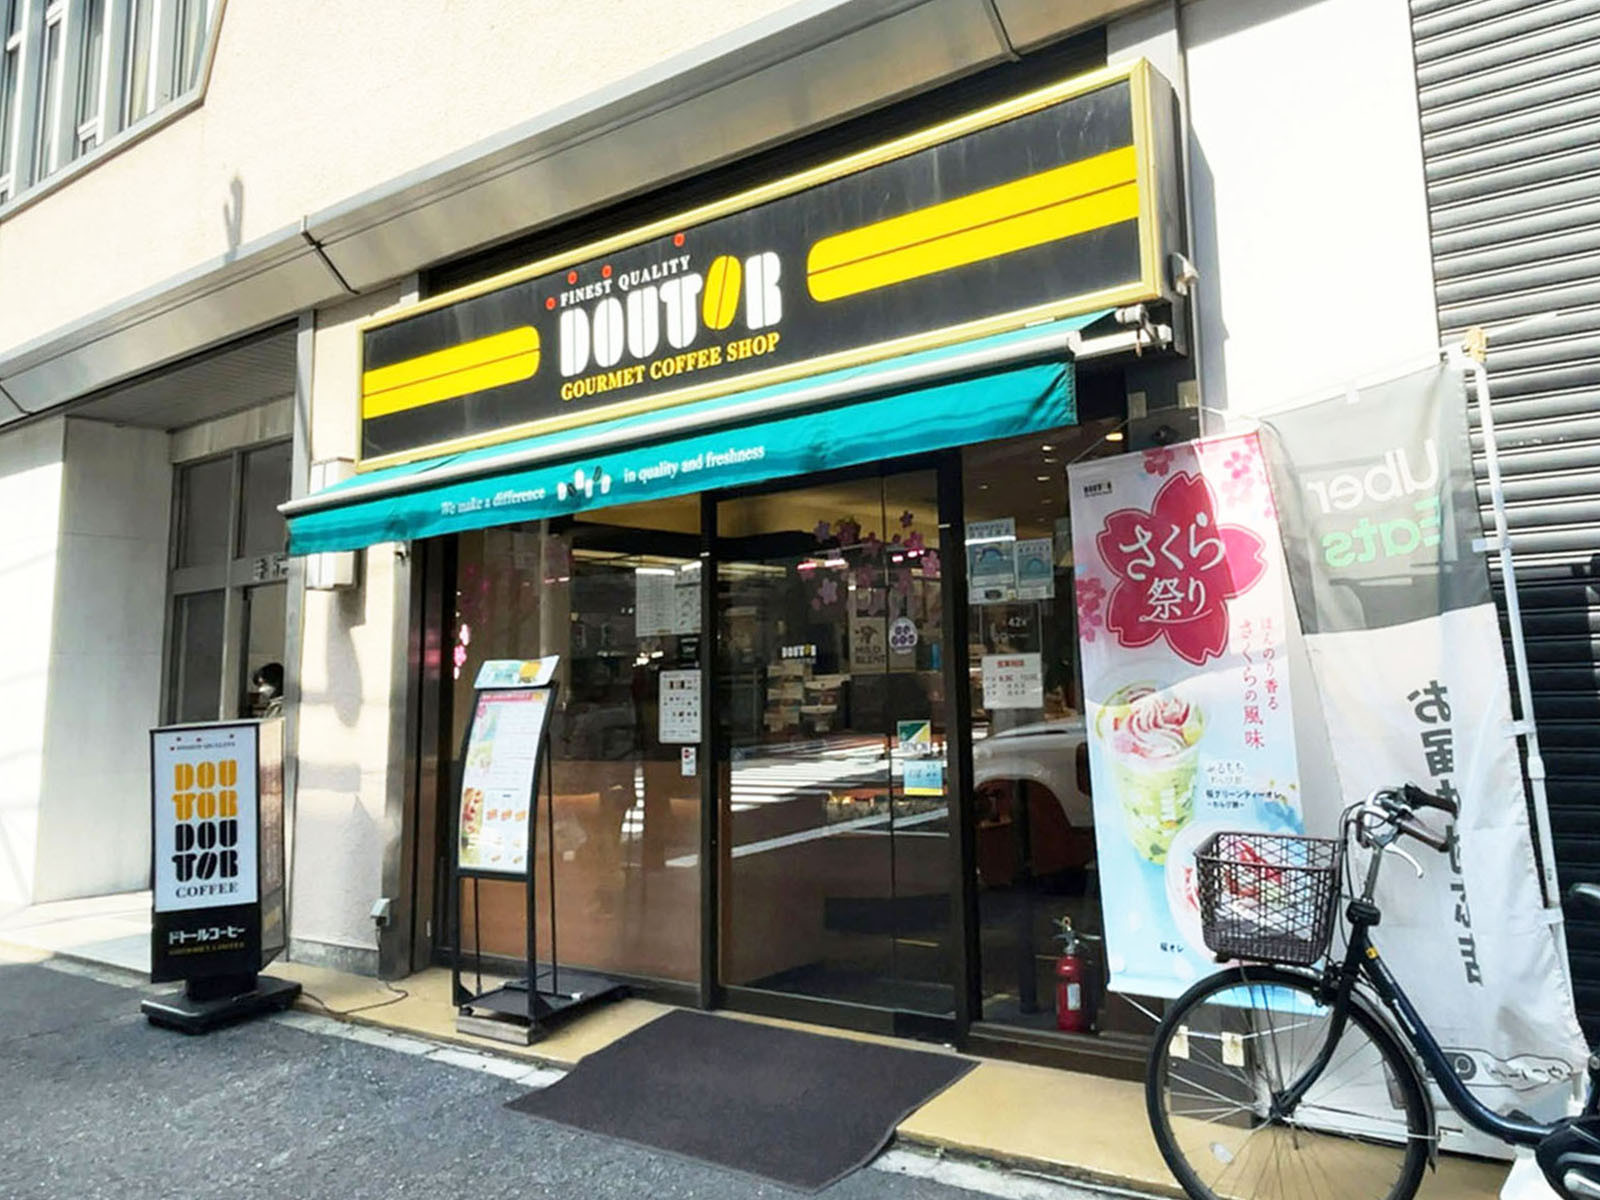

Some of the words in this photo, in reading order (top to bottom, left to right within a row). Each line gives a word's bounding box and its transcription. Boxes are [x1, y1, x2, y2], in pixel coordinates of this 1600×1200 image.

[560, 279, 613, 307] FINEST
[618, 254, 690, 291] QUALITY
[559, 251, 782, 378] DOUTOR
[560, 364, 646, 401] GOURMET
[649, 346, 722, 380] COFFEE
[726, 331, 780, 362] SHOP
[458, 497, 482, 512] make
[485, 499, 490, 507] a
[493, 487, 546, 507] difference
[624, 468, 636, 483] in
[639, 460, 678, 484] quality
[681, 454, 703, 473] and
[706, 445, 765, 468] freshness
[1119, 511, 1225, 580] さくら
[1148, 577, 1206, 620] 祭り
[1240, 619, 1265, 749] さくらの風味
[174, 759, 238, 791] DOU
[171, 789, 238, 821] TOR
[175, 819, 238, 852] DOU
[171, 849, 238, 882] TOR
[175, 882, 239, 899] COFFEE
[169, 926, 246, 945] ドトールコーヒー
